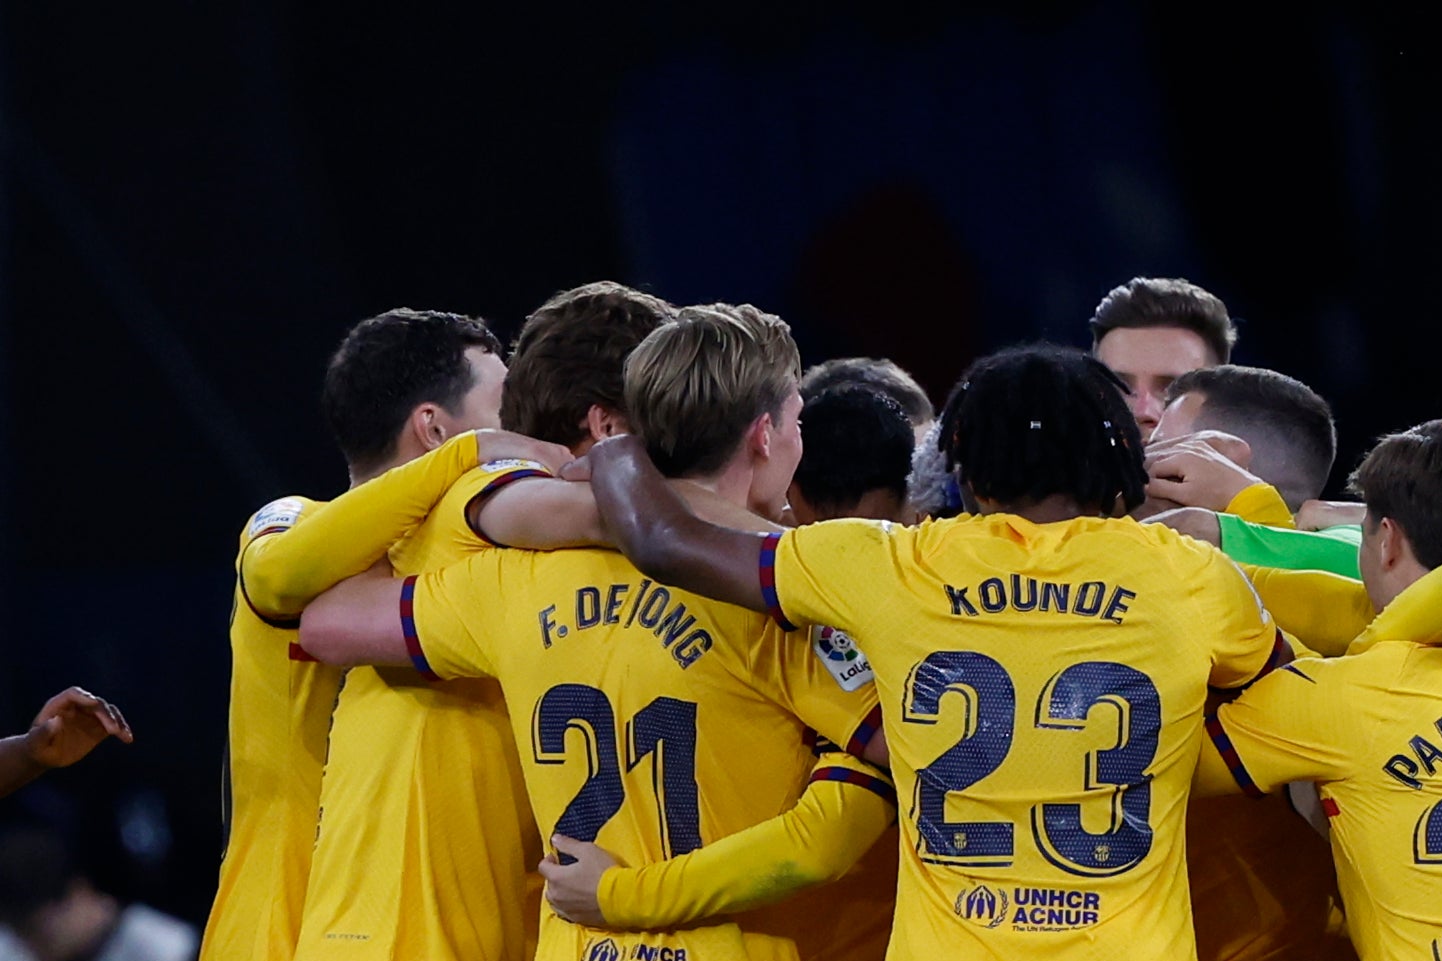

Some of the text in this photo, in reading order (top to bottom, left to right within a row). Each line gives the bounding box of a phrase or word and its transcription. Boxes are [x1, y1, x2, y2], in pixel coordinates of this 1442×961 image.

[943, 573, 1137, 625] KOUNDE
[538, 604, 568, 650] F.
[839, 660, 873, 682] LaLig
[531, 682, 703, 867] 21
[902, 650, 1162, 878] 23
[1012, 907, 1099, 926] ACNUR
[1014, 887, 1100, 911] UNHCR
